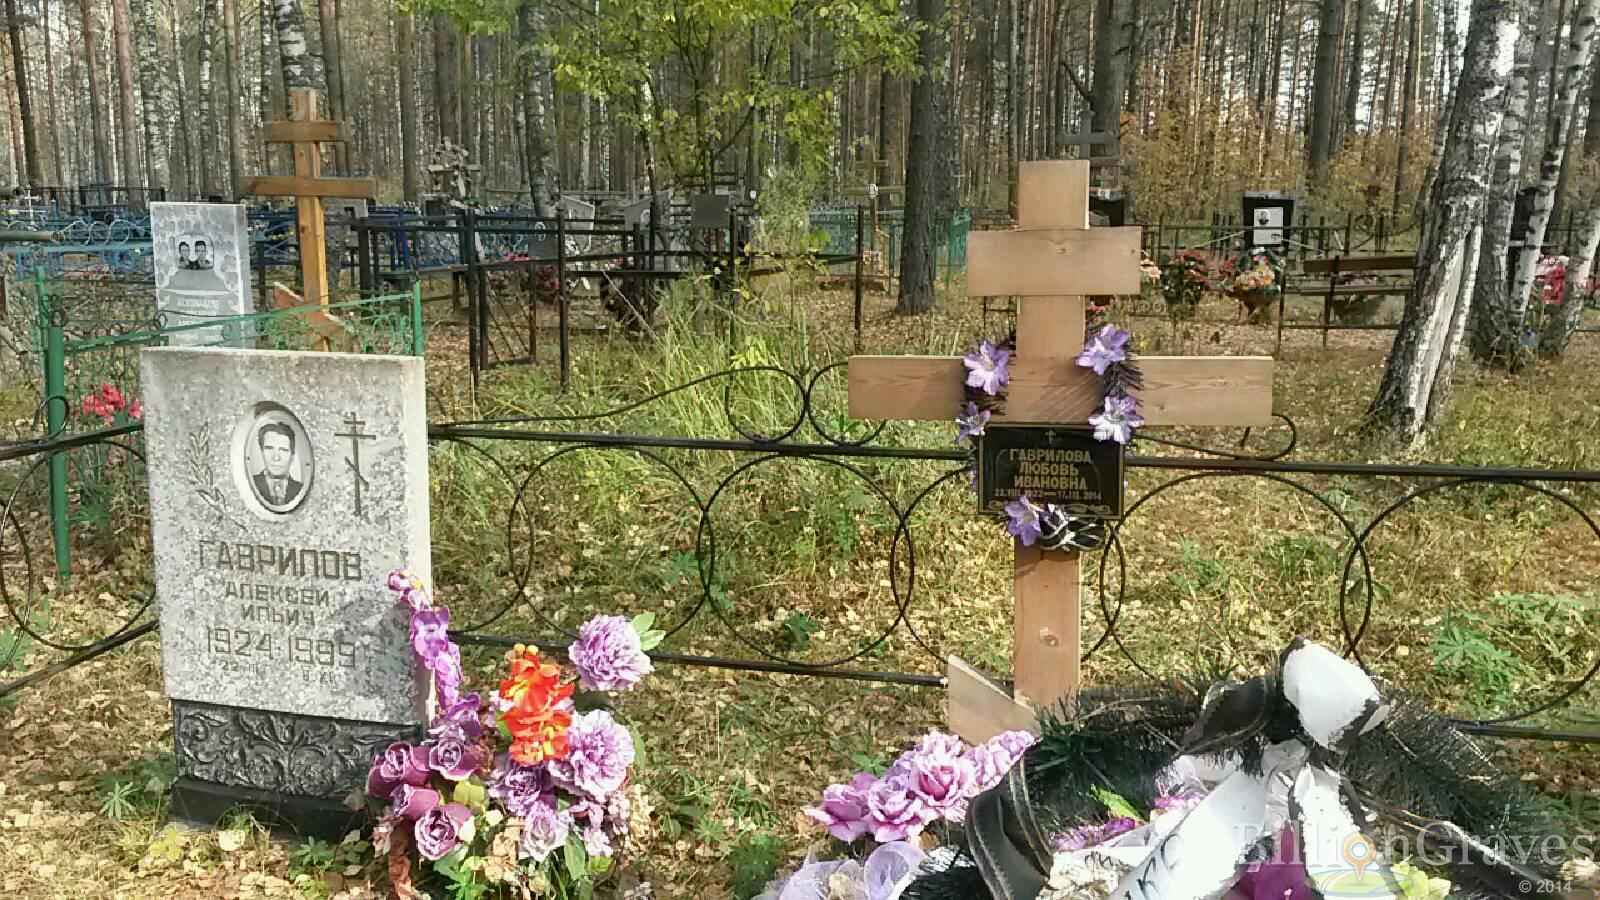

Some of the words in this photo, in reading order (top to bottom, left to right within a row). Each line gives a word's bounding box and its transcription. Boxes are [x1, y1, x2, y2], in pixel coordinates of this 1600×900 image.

[1009, 449, 1092, 464] ГАВРИЛОВА
[1019, 462, 1079, 476] ЛЮБОВЬ
[1014, 475, 1088, 490] ИВАНОВНА
[199, 540, 362, 581] ГАВРИЛОВ
